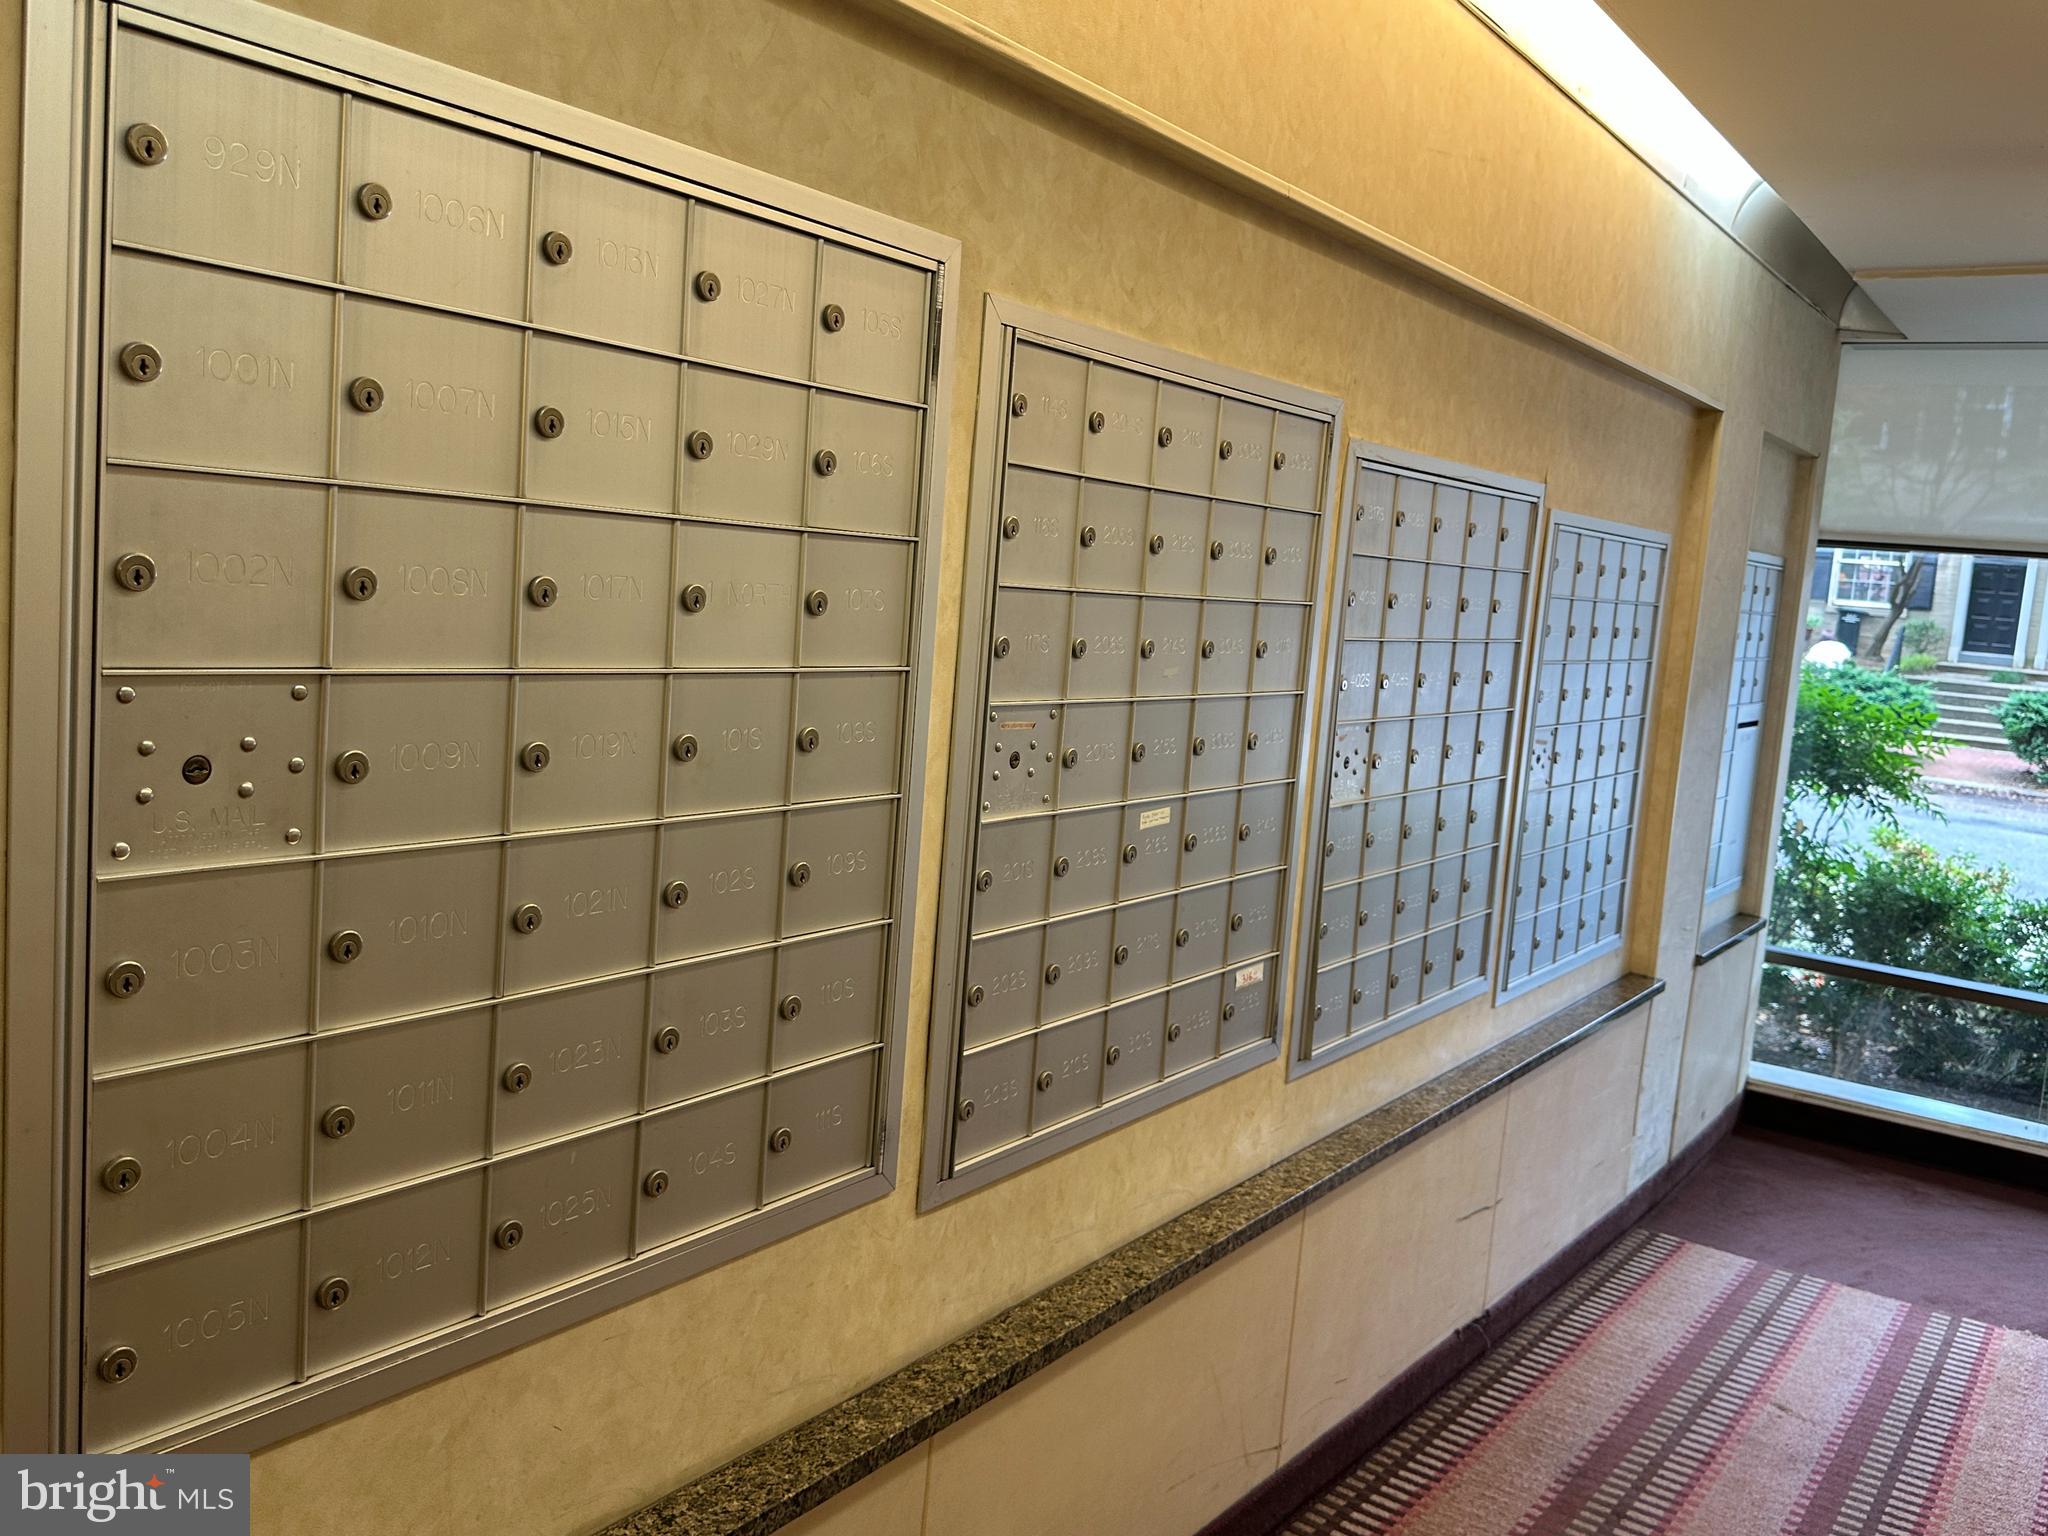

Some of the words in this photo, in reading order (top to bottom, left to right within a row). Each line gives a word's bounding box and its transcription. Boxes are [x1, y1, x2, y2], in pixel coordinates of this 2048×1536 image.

[202, 135, 301, 190] 929N
[415, 188, 506, 240] 1006N
[593, 238, 658, 281] 1013N
[735, 274, 799, 314] 1027N
[862, 308, 904, 342] 105S
[198, 344, 296, 392] 1001N
[406, 377, 497, 423] 1007N
[585, 407, 654, 442] 1015N
[726, 430, 789, 463] 1029N
[185, 551, 296, 588] 1002N
[400, 564, 489, 598] 1008N
[579, 573, 644, 603] 1017N
[727, 581, 792, 608] NORTH
[845, 587, 886, 612] 107S
[390, 741, 482, 773] 1009N
[570, 731, 638, 760] 1019N
[720, 727, 765, 753] 101S
[152, 809, 196, 834] U.S.
[210, 806, 266, 827] MAIL
[825, 849, 871, 876] 109S
[708, 866, 758, 896] 102S
[563, 885, 631, 920] 1021N
[387, 908, 471, 945] 1010N
[170, 934, 281, 980] 1003N
[820, 977, 857, 1006] 110S
[699, 1004, 749, 1039] 103S
[548, 1034, 624, 1075] 1023N
[386, 1076, 456, 1116] 1011N
[166, 1114, 279, 1169] 1004N
[688, 1142, 738, 1177] 104S
[539, 1184, 616, 1230] 1025N
[376, 1238, 453, 1283] 1012N
[160, 1291, 271, 1353] 1005N
